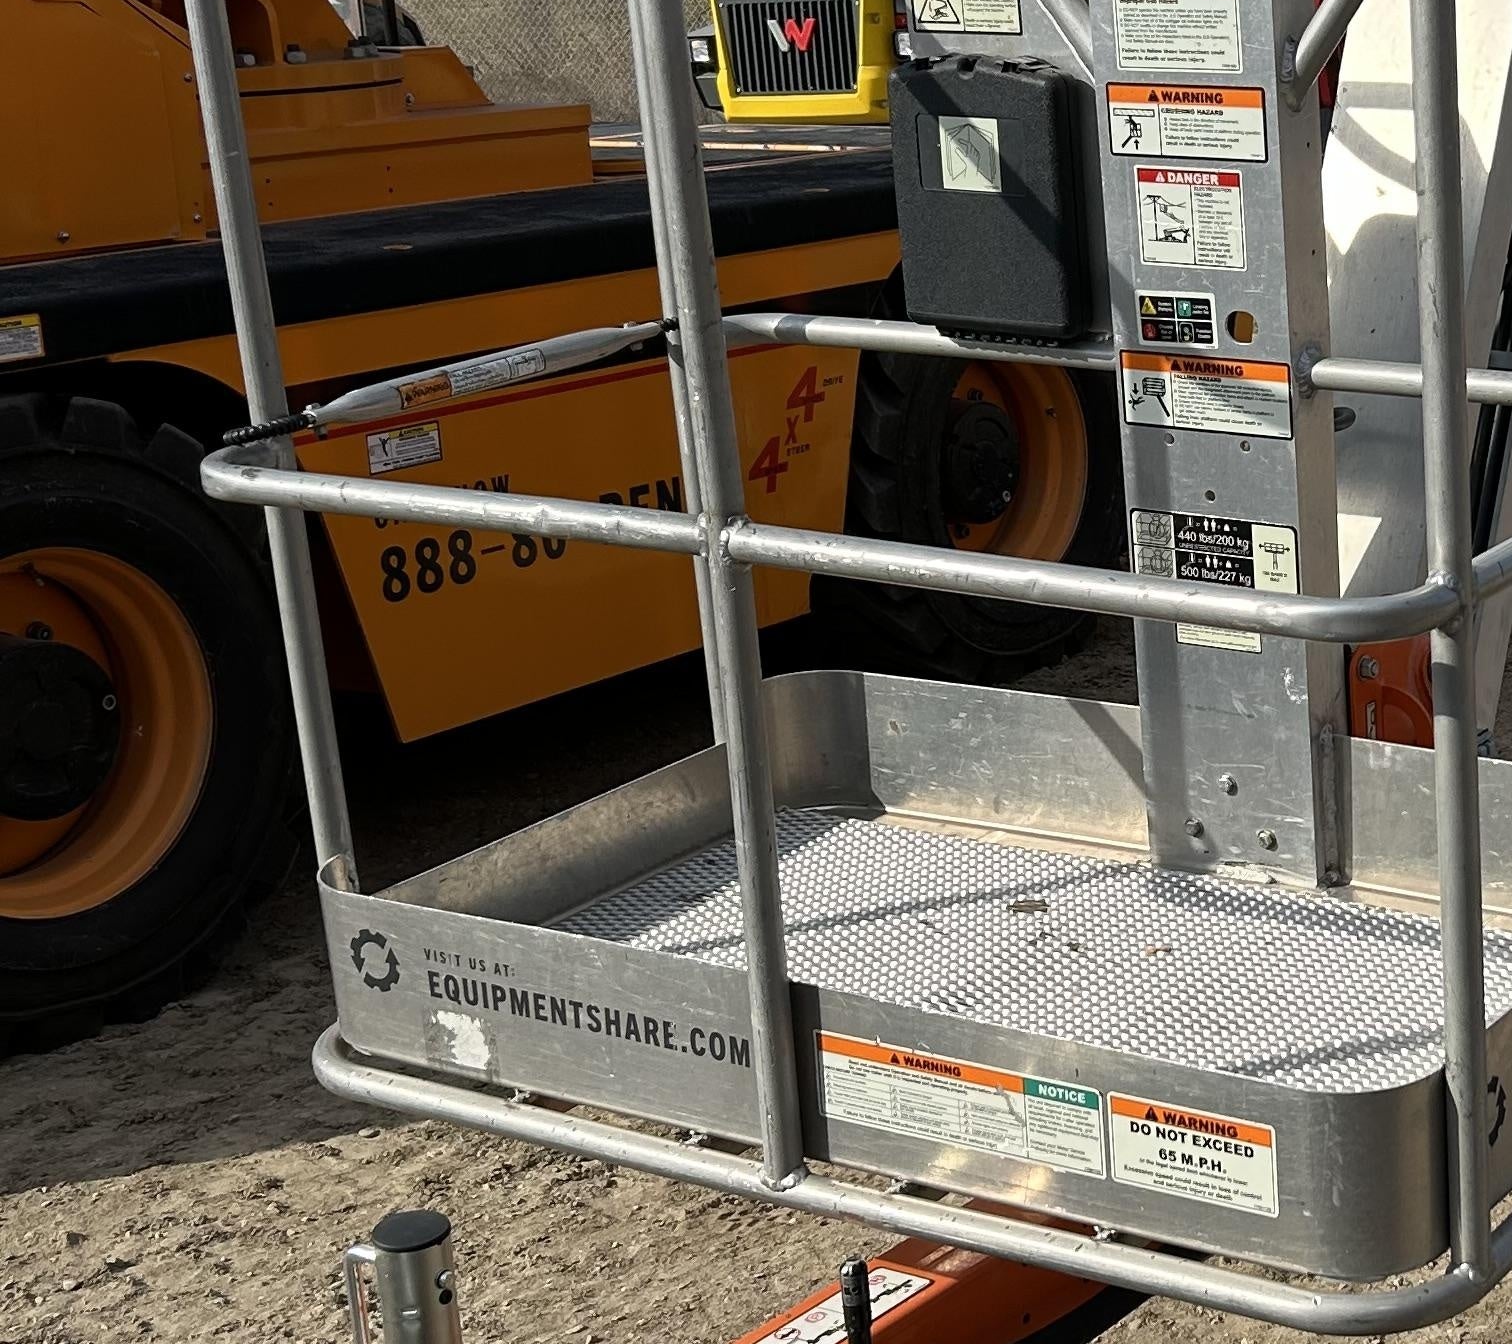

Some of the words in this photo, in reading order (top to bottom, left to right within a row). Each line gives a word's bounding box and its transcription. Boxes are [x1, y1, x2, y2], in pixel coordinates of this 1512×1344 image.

[1161, 91, 1224, 103] WARNING
[1167, 172, 1219, 185] DANGER
[1183, 362, 1244, 376] WARNING
[786, 365, 826, 423] 4
[823, 376, 843, 387] DRIVE
[748, 436, 789, 494] 4
[786, 444, 811, 456] STEER
[1178, 531, 1196, 541] 440
[1199, 532, 1234, 546] lbs/200
[1237, 538, 1249, 550] kg
[1181, 567, 1198, 577] 500
[1201, 569, 1235, 581] lbs/227
[1239, 575, 1251, 585] kg
[423, 948, 461, 967] VISIT
[468, 957, 486, 972] US
[493, 963, 516, 977] AT:
[427, 970, 750, 1068] EQUIPMENTSHARE.COM
[903, 1055, 962, 1077] WARNING
[1038, 1083, 1086, 1104] NOTICE
[1163, 1111, 1238, 1138] WARNING
[1130, 1121, 1151, 1135] DO
[1156, 1126, 1187, 1144] NOT
[1192, 1135, 1254, 1157] EXCEED
[1159, 1148, 1176, 1161] 65
[1181, 1154, 1227, 1173] M.P.H.
